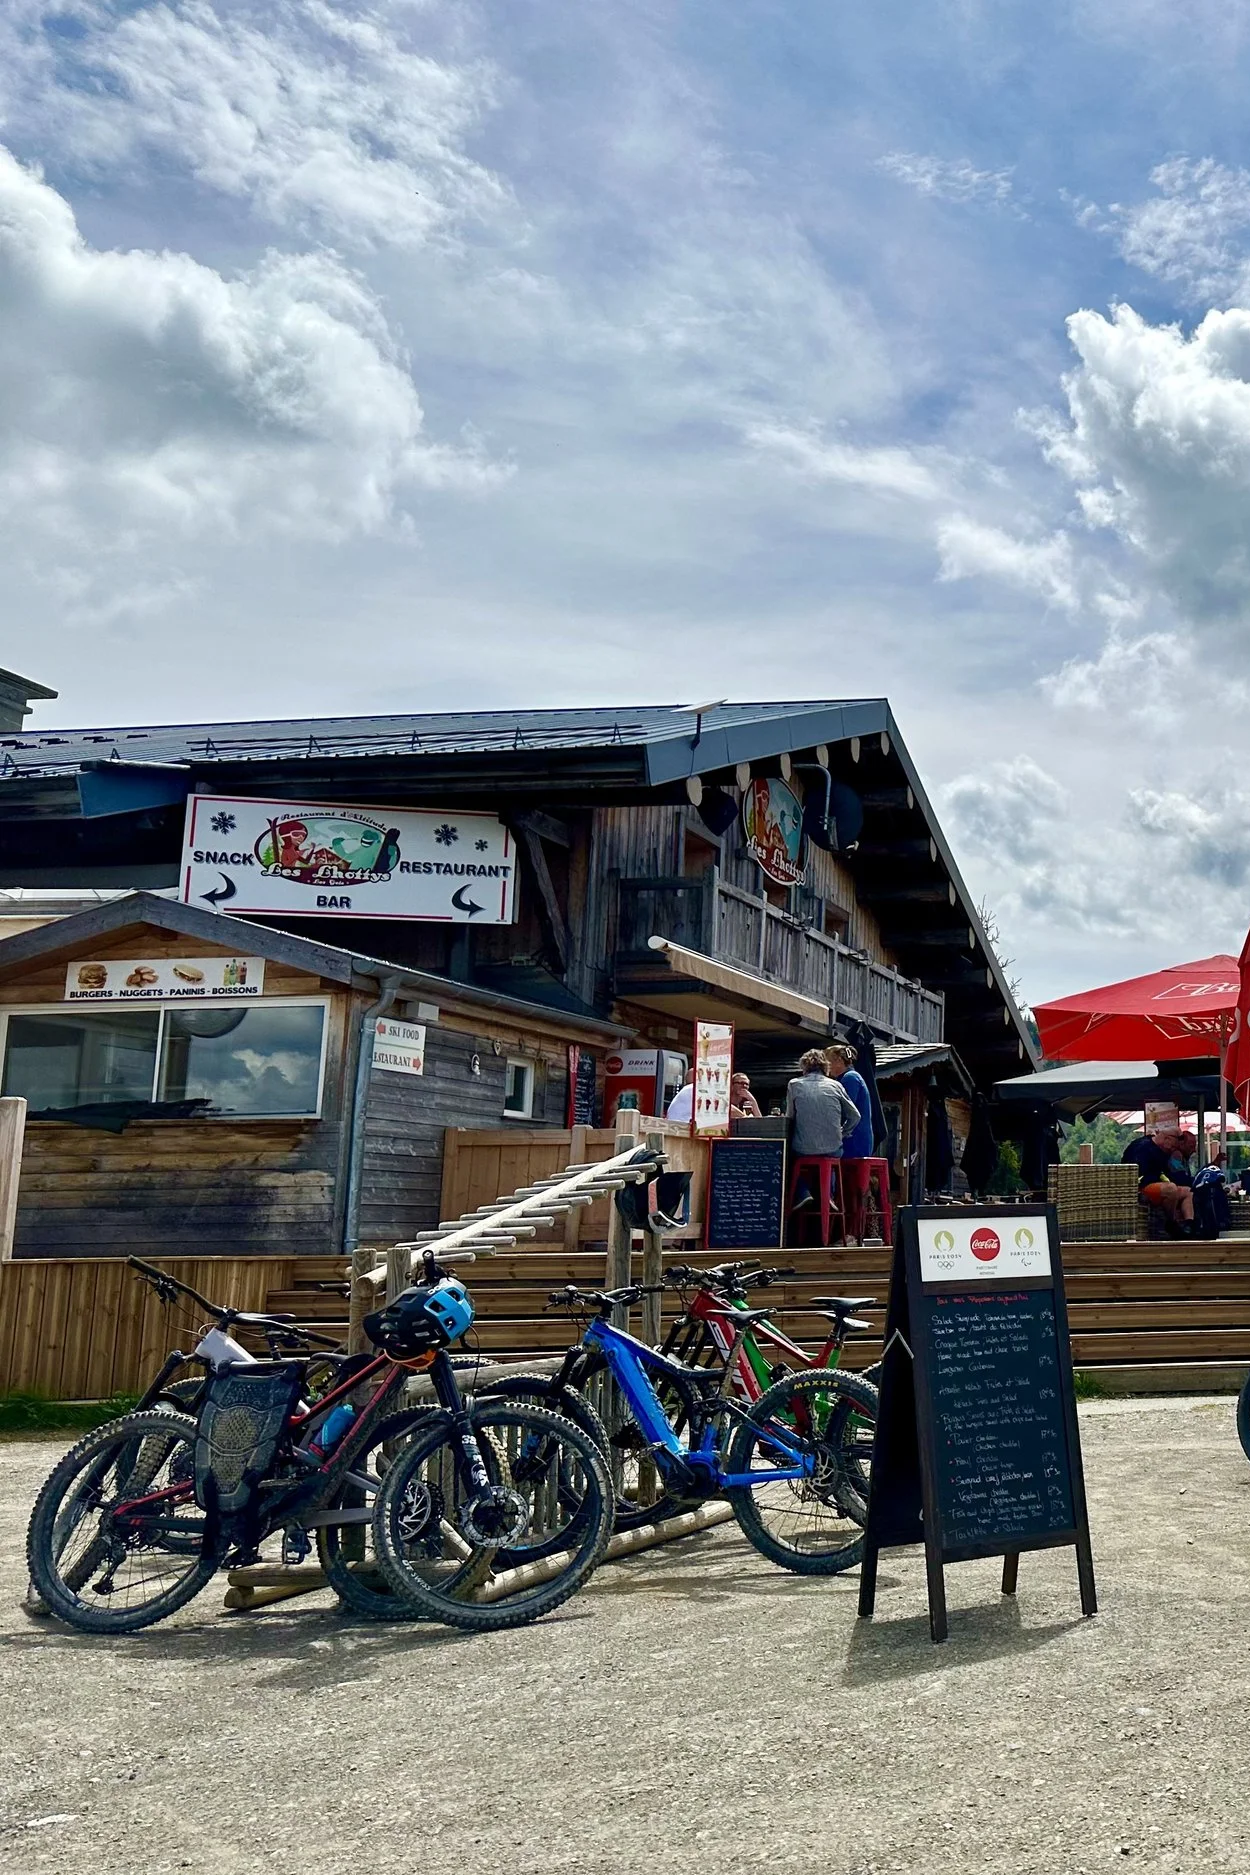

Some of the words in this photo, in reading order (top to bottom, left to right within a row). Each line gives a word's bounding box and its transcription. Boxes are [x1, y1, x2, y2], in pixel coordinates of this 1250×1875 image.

[281, 811, 336, 820] Restaurant
[193, 850, 255, 866] SNACK
[261, 862, 301, 877] Les
[312, 863, 391, 883] Lhottys
[400, 860, 512, 879] RESTAURANT
[316, 895, 353, 910] BAR
[70, 990, 113, 999] BURGERS
[119, 989, 163, 997] NUGGETS
[169, 988, 206, 996] PANINIS
[212, 986, 258, 995] BOISSONS
[388, 1026, 400, 1037] SKI
[402, 1028, 420, 1040] FOOD
[373, 1052, 411, 1067] ESTAURANT
[971, 1238, 999, 1249] Coca-Cola
[794, 1380, 839, 1391] MAXXIS
